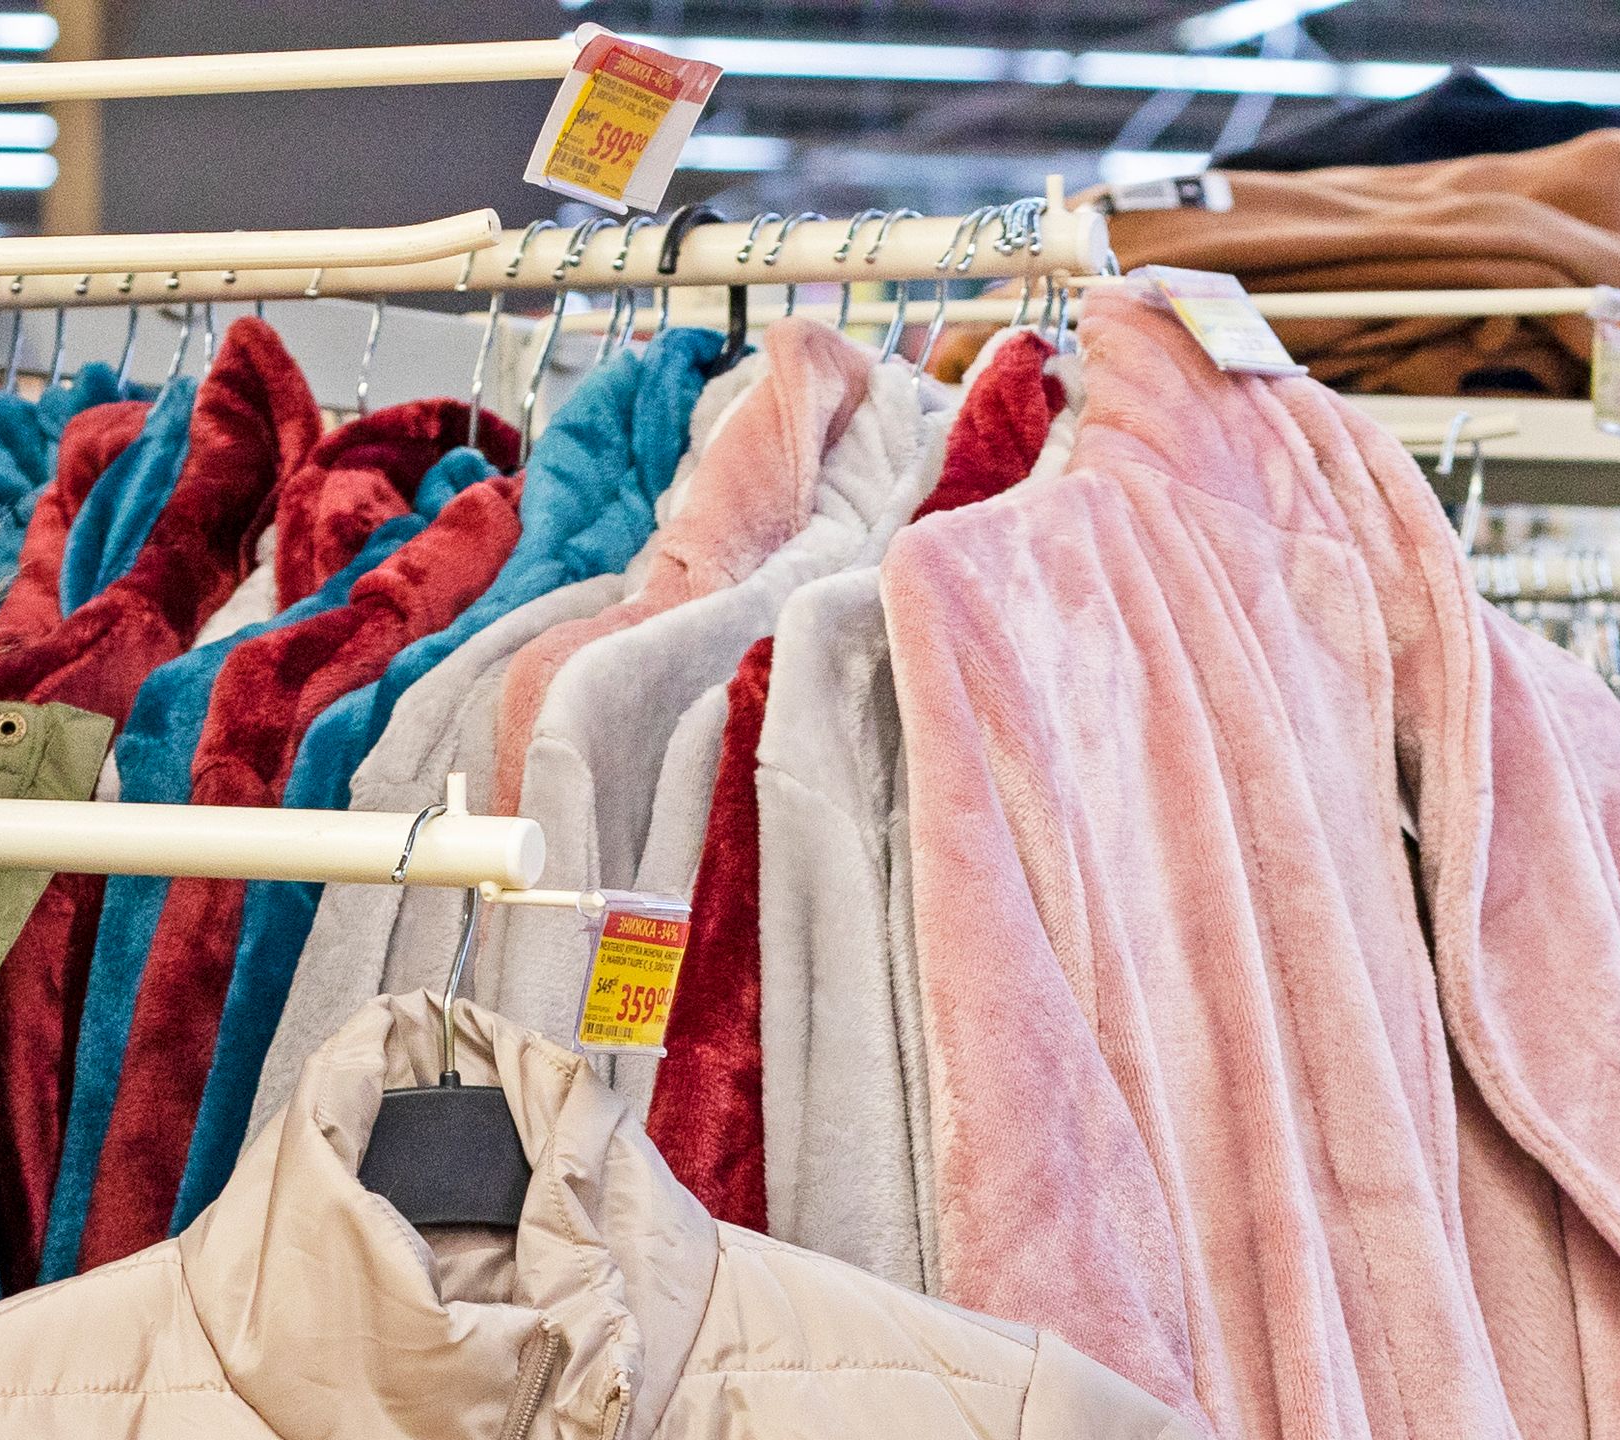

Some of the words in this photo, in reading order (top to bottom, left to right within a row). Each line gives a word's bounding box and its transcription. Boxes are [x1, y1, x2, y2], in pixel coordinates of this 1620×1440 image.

[587, 121, 632, 165] 599
[617, 916, 657, 938] ЗНИЖКА
[616, 983, 657, 1024] 359
